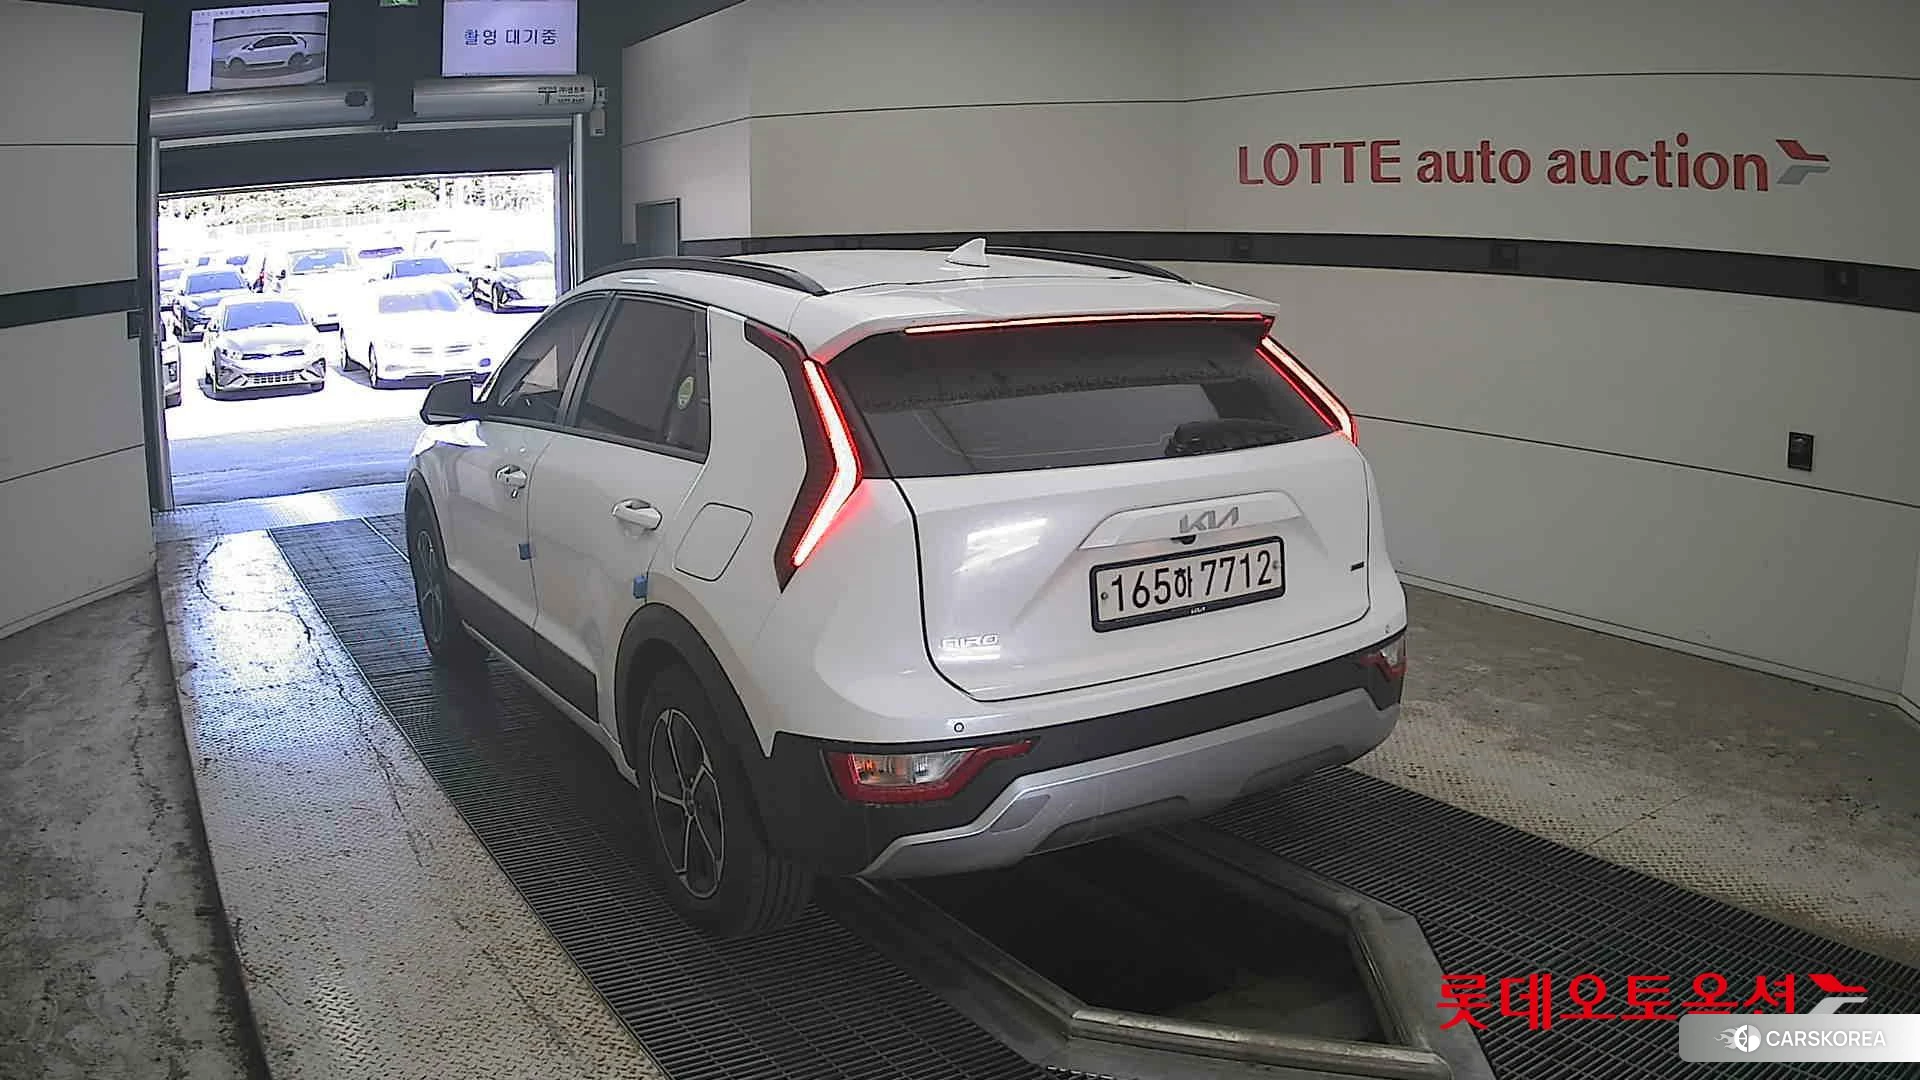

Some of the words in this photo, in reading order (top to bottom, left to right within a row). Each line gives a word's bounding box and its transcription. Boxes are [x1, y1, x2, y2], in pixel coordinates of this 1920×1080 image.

[505, 29, 557, 46] 대기중
[1238, 139, 1401, 186] LOTTE
[1416, 139, 1532, 185] auto
[1546, 132, 1770, 192] auction
[1179, 506, 1240, 534] KIA
[1111, 564, 1193, 612] 165하
[1200, 549, 1273, 597] 7712
